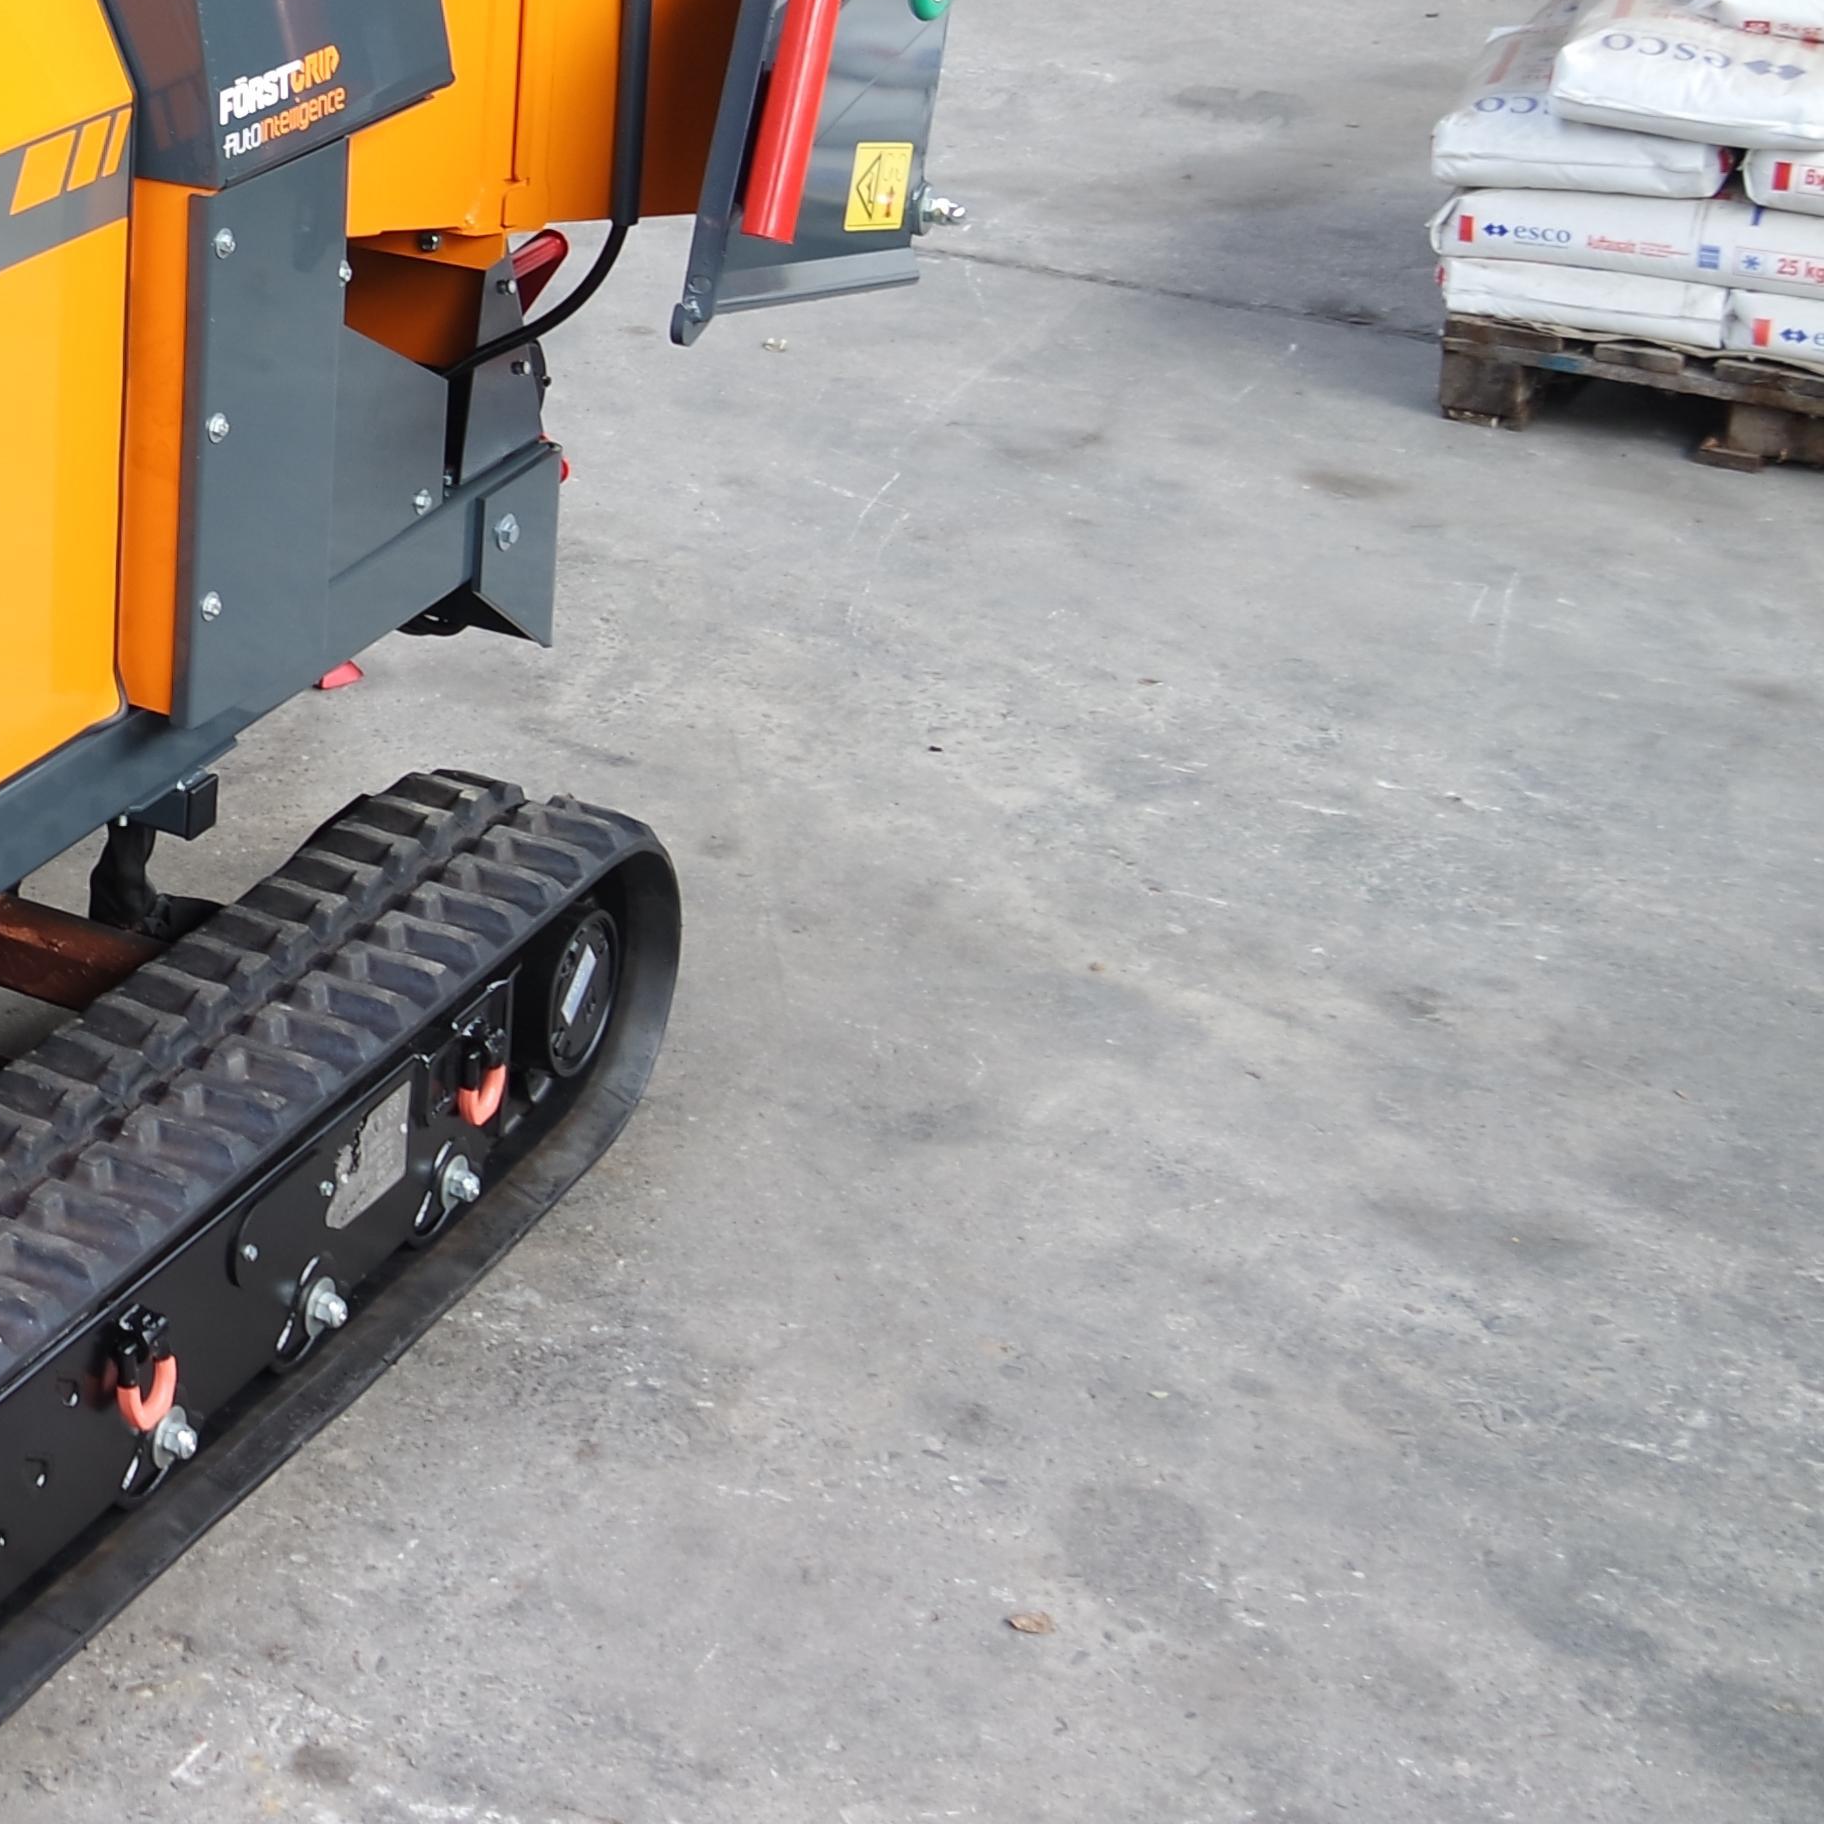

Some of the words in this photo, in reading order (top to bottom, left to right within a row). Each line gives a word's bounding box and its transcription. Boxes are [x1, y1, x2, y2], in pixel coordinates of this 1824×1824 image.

[1602, 32, 1732, 69] esco
[1513, 224, 1571, 243] esco
[1777, 257, 1798, 276] 25
